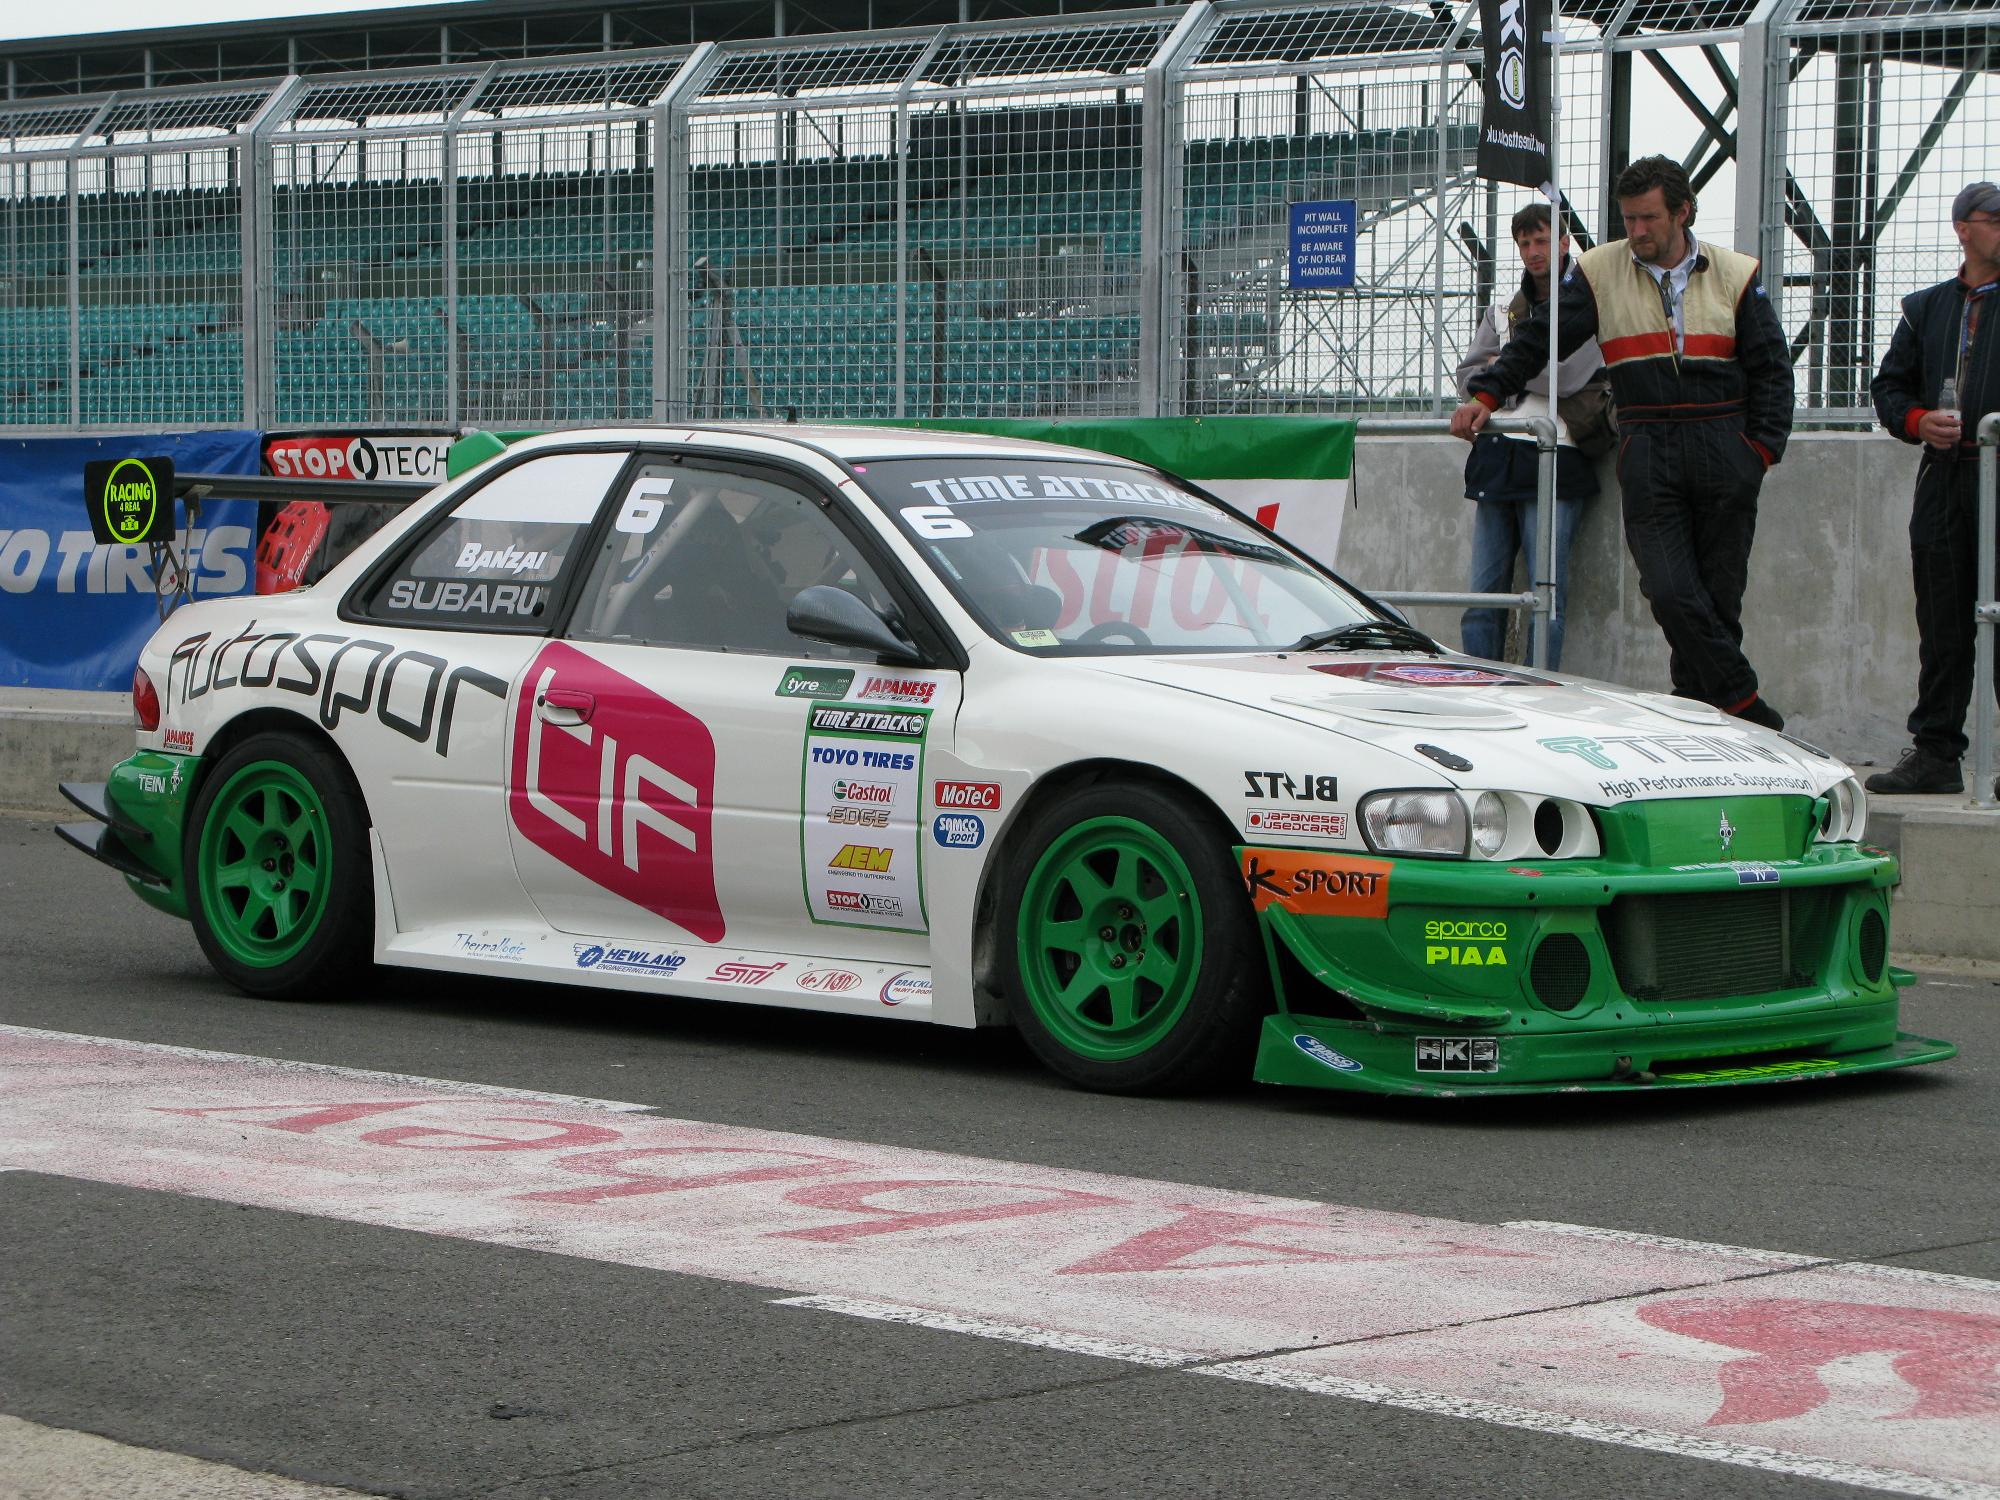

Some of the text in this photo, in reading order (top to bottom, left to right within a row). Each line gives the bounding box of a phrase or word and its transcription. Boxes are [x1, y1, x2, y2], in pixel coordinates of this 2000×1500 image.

[1304, 212, 1342, 222] PIT WALL
[1297, 224, 1348, 235] INCOMPLETE
[1301, 242, 1343, 252] BE AWARE
[1297, 254, 1347, 264] OF NO REAR
[1301, 267, 1343, 276] HANDRAIL
[272, 446, 450, 477] STOP TECH
[110, 482, 151, 502] RACING
[119, 502, 141, 512] 4 REAL
[615, 477, 674, 534] 6
[900, 505, 974, 539] 6
[56, 525, 251, 594] TIRES
[388, 580, 541, 615] SUBARU
[858, 677, 938, 699] JAPANESE
[164, 728, 195, 748] JAPANESE
[812, 747, 915, 771] TOYO TIRES
[1592, 735, 1788, 765] TEIN
[138, 773, 167, 794] TEIN
[847, 782, 892, 803] Castrol
[1599, 772, 1814, 799] High Performance Suspension
[940, 784, 995, 806] MoTeC
[826, 805, 891, 828] EDGE
[939, 817, 978, 833] SAMCO
[949, 832, 975, 843] sport
[828, 844, 894, 873] AEM
[828, 893, 901, 911] STOP TECH
[1425, 920, 1507, 940] sparco
[605, 948, 687, 967] HEWLAND
[1426, 946, 1508, 966] PIAA
[596, 964, 674, 978] ENGINEERING LIMITED
